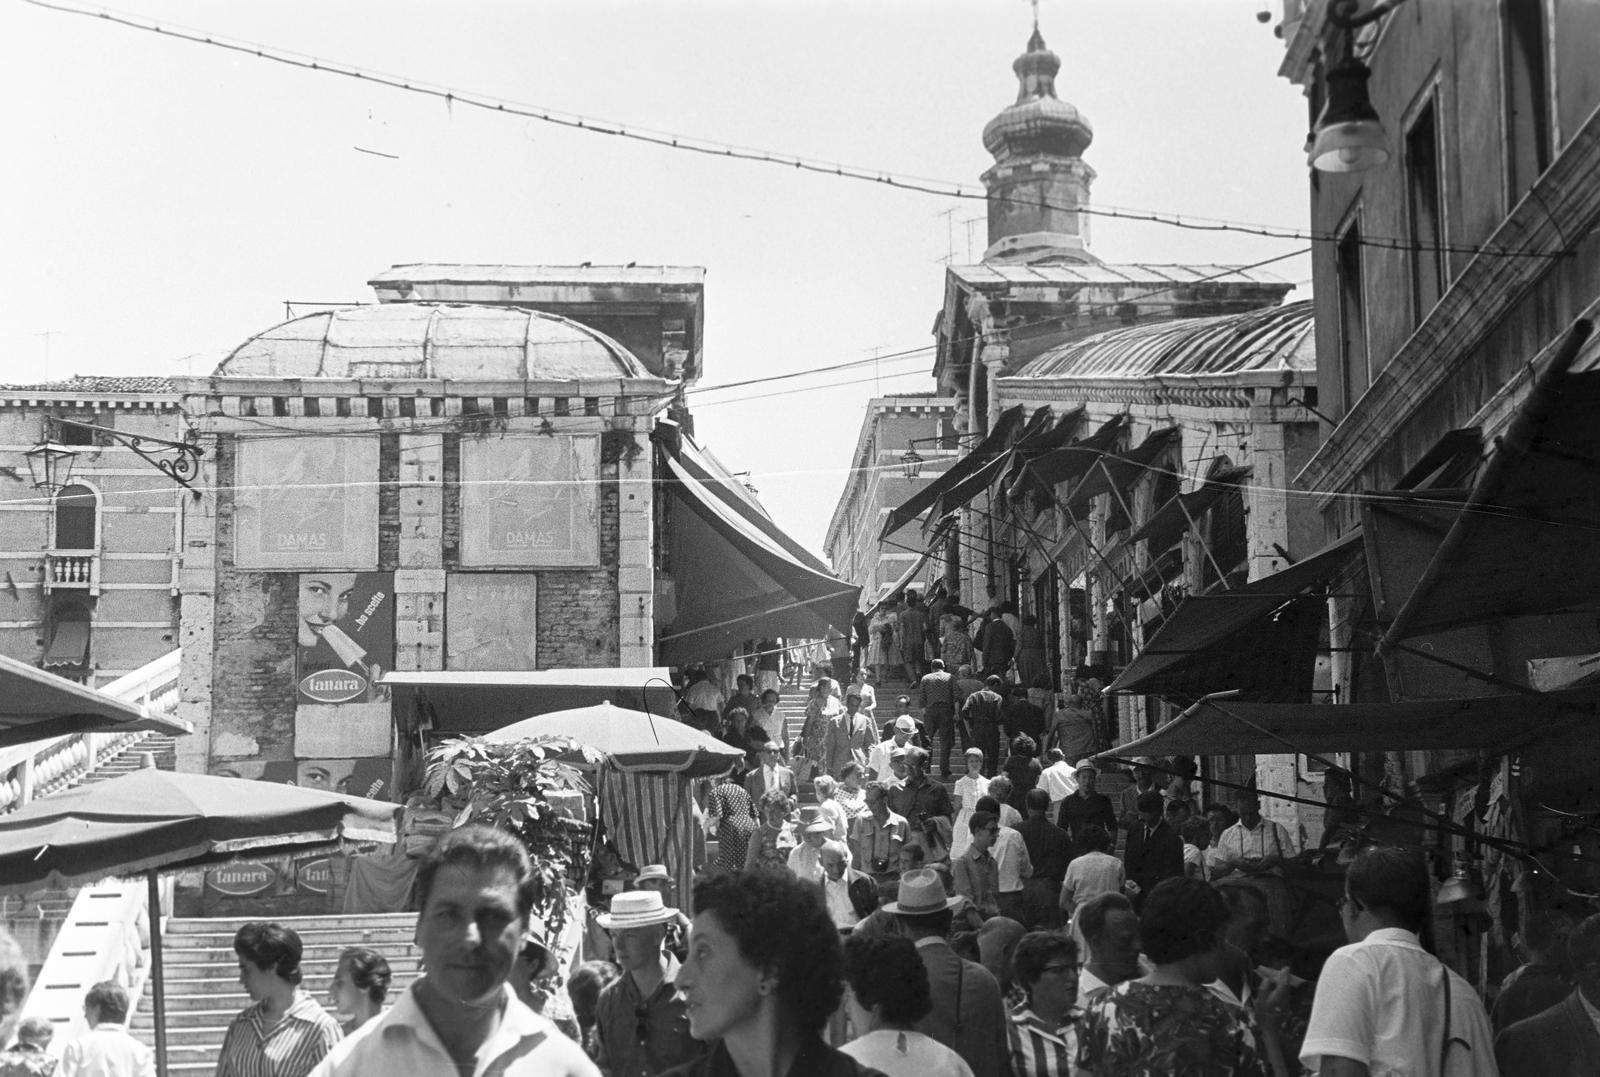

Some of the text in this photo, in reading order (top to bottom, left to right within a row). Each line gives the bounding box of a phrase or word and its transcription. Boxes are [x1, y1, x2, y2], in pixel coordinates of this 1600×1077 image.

[279, 533, 327, 545] DAMAS
[506, 531, 554, 544] DAMAS
[364, 591, 386, 616] scelto
[309, 678, 360, 692] tanara
[216, 869, 268, 884] tanara
